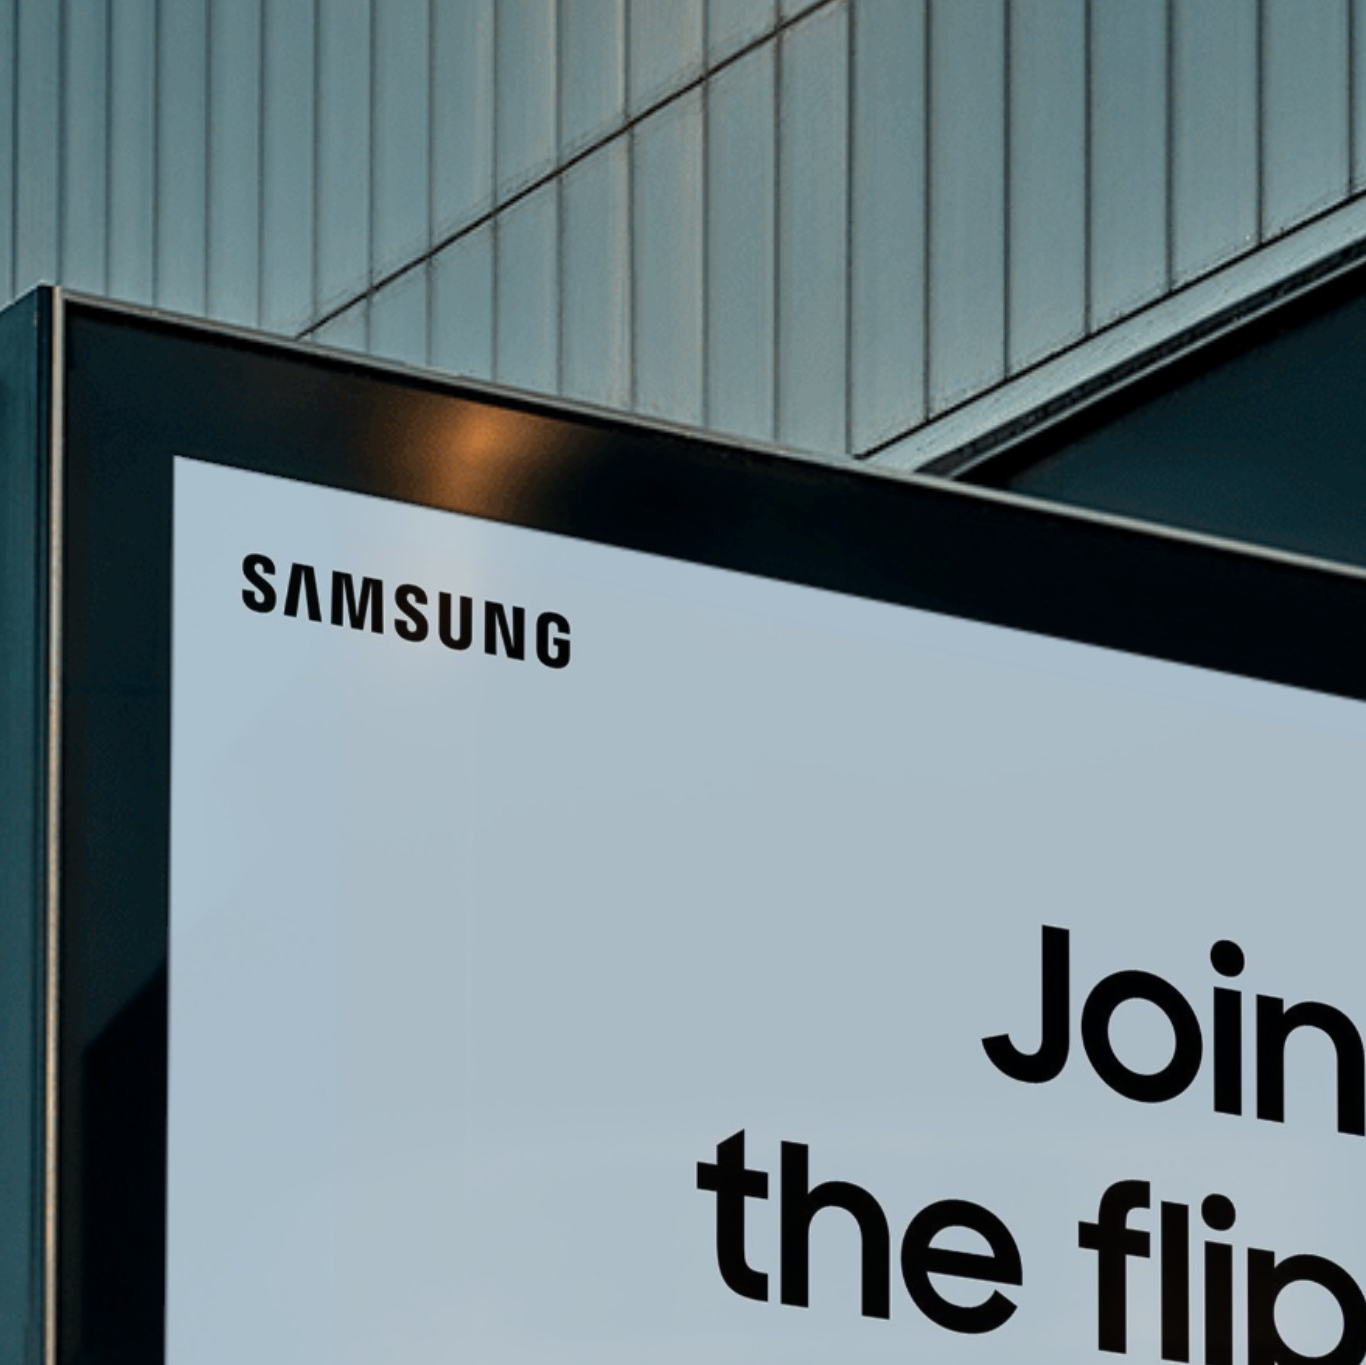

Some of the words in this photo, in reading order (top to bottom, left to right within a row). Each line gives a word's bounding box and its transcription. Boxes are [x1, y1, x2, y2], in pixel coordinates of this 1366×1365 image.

[241, 553, 571, 669] SAMSUNG
[981, 924, 1366, 1137] Join
[696, 1128, 1023, 1335] the
